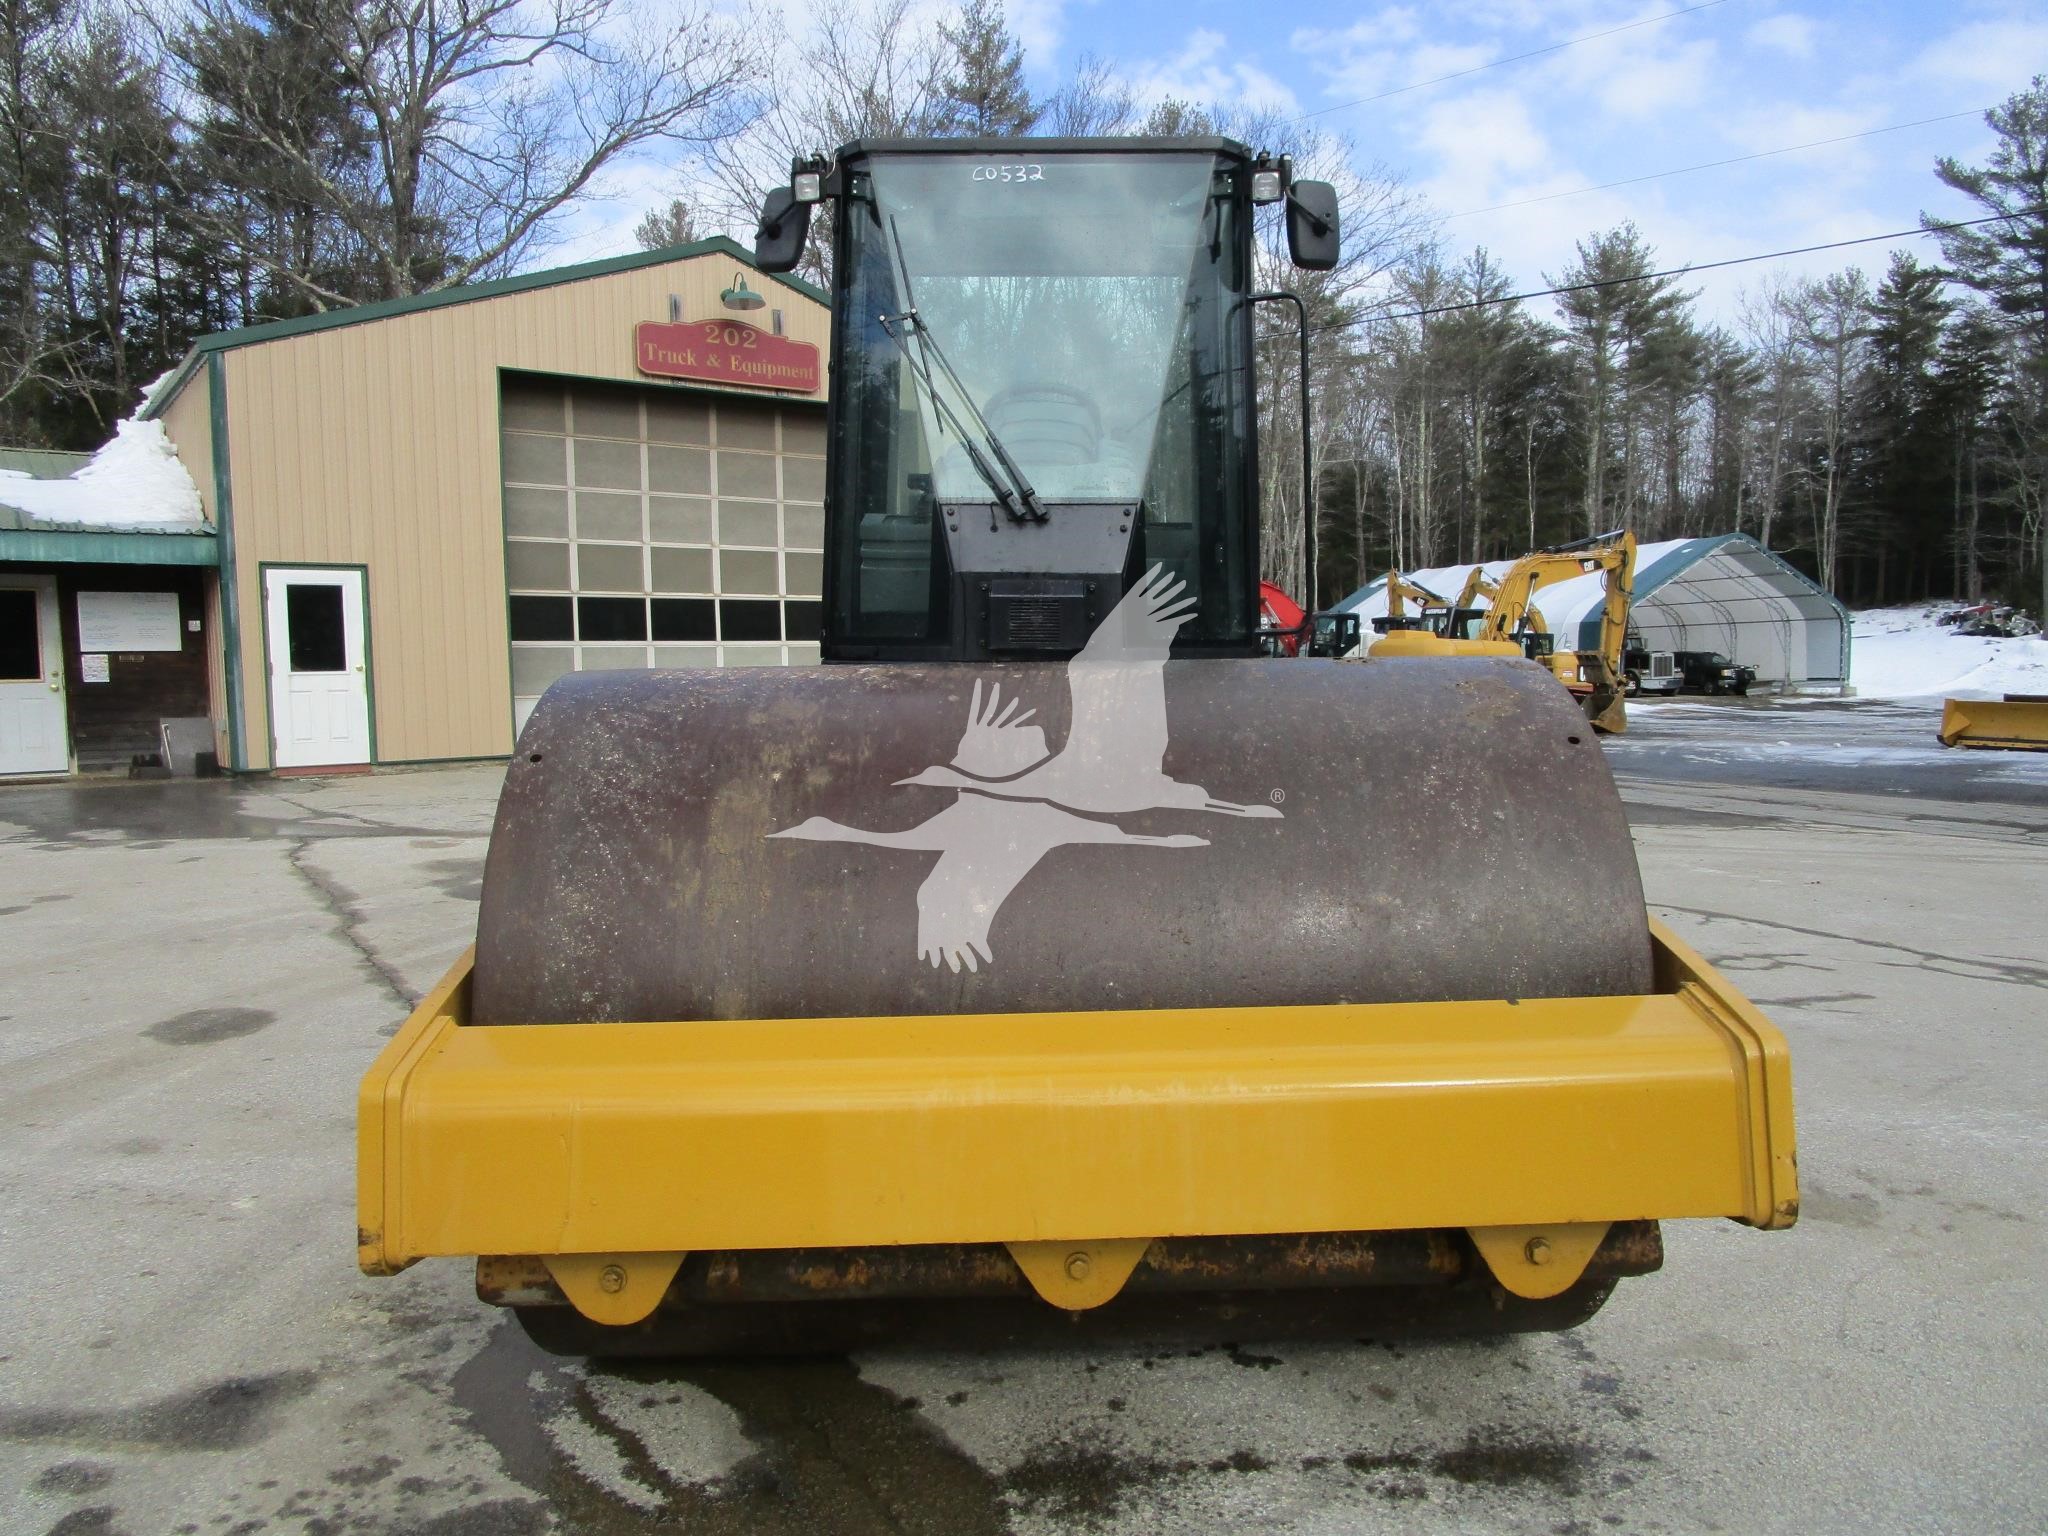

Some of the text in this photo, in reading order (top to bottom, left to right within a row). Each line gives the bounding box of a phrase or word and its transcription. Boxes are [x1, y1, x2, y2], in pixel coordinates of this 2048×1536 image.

[705, 325, 757, 348] 202
[644, 343, 814, 380] Truck & Equipment
